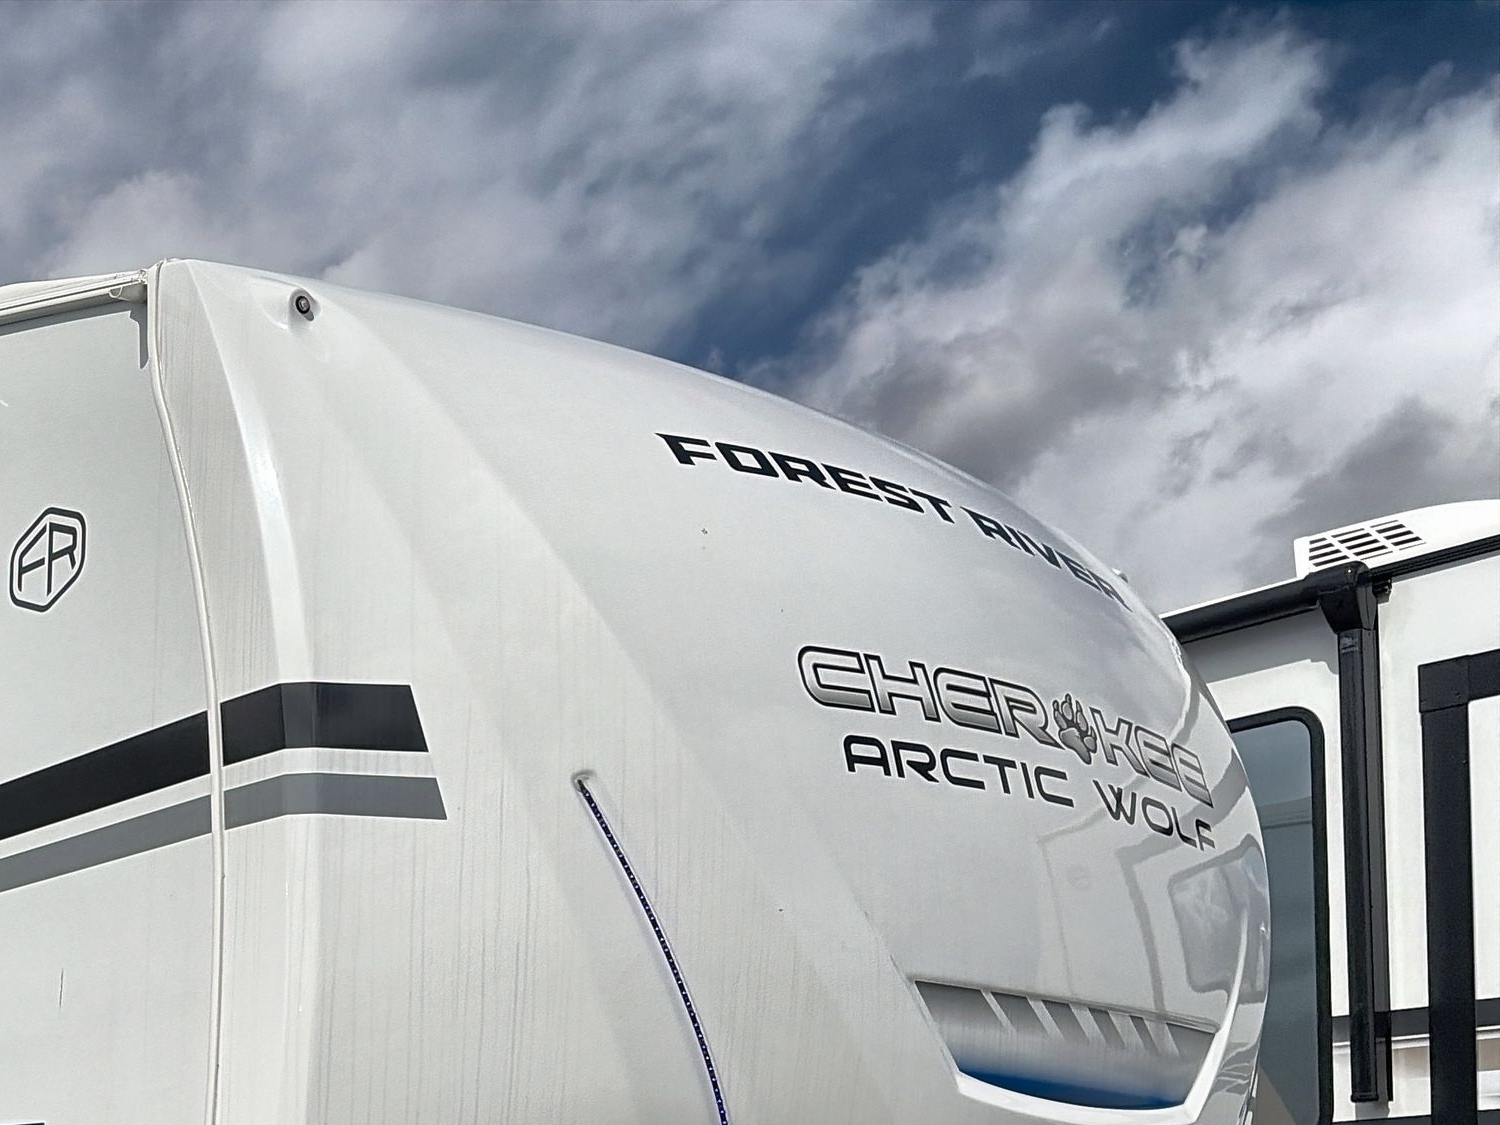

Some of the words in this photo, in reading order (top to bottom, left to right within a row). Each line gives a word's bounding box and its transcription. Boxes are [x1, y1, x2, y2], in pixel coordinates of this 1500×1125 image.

[655, 432, 955, 523] FOREST
[960, 506, 1133, 612] RIVER
[842, 734, 1075, 808] ARCTIC
[1092, 779, 1216, 851] WOLF
